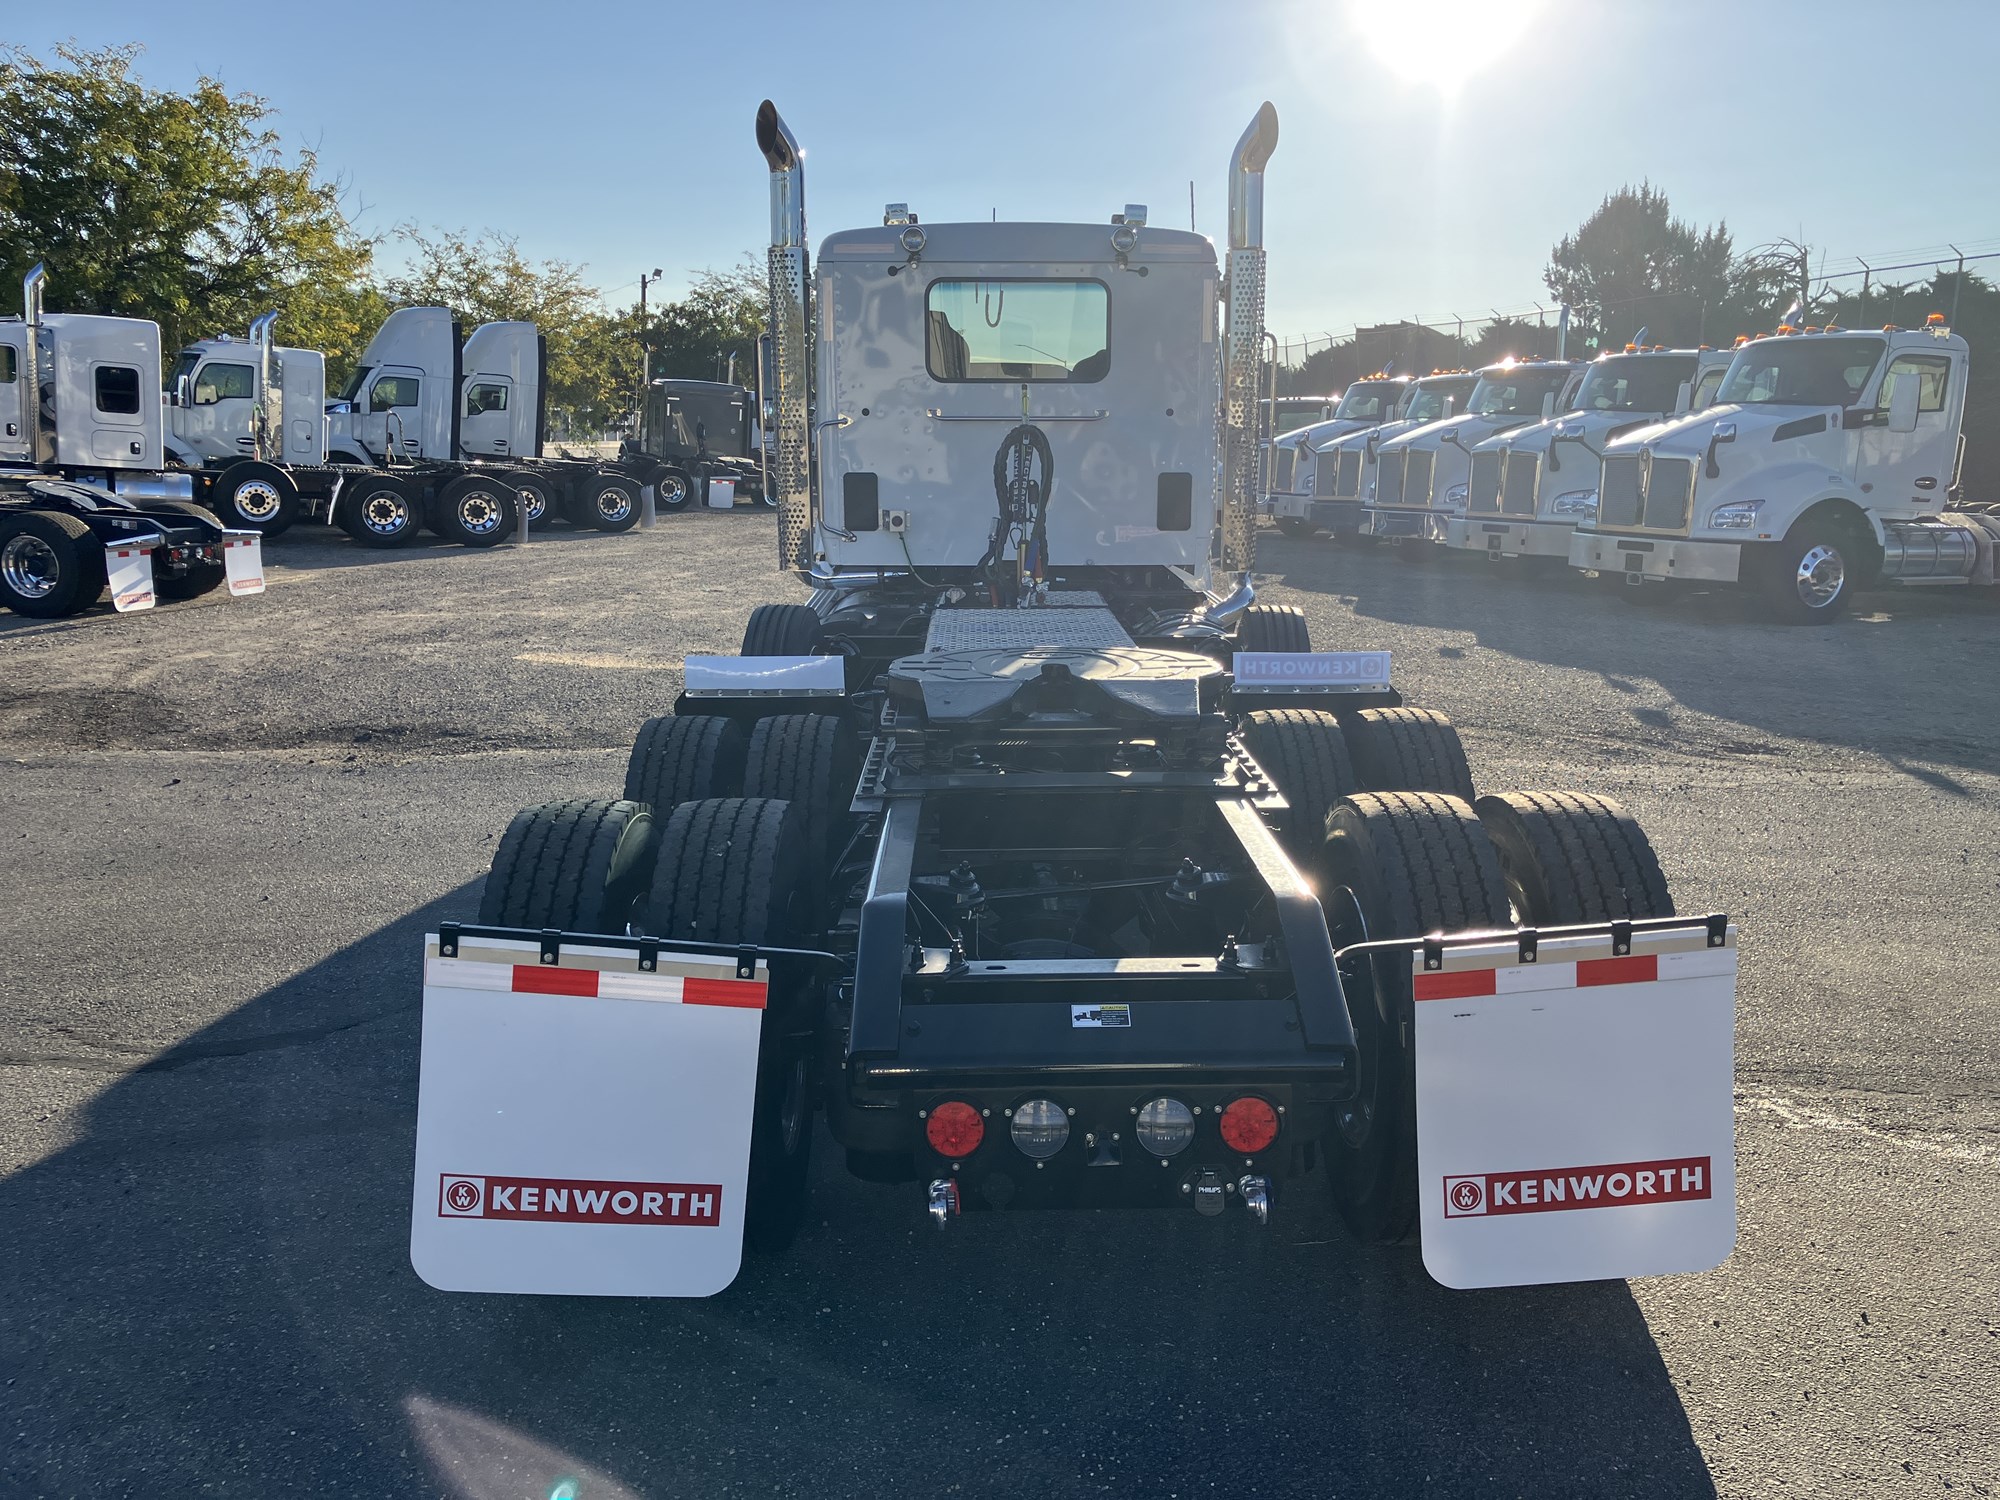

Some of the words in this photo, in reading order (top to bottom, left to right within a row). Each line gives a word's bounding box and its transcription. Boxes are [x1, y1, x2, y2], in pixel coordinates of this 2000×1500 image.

[1020, 453, 1032, 504] TECTRAN
[492, 1186, 713, 1217] KENWORTH
[1493, 1166, 1703, 1206] KENWORTH
